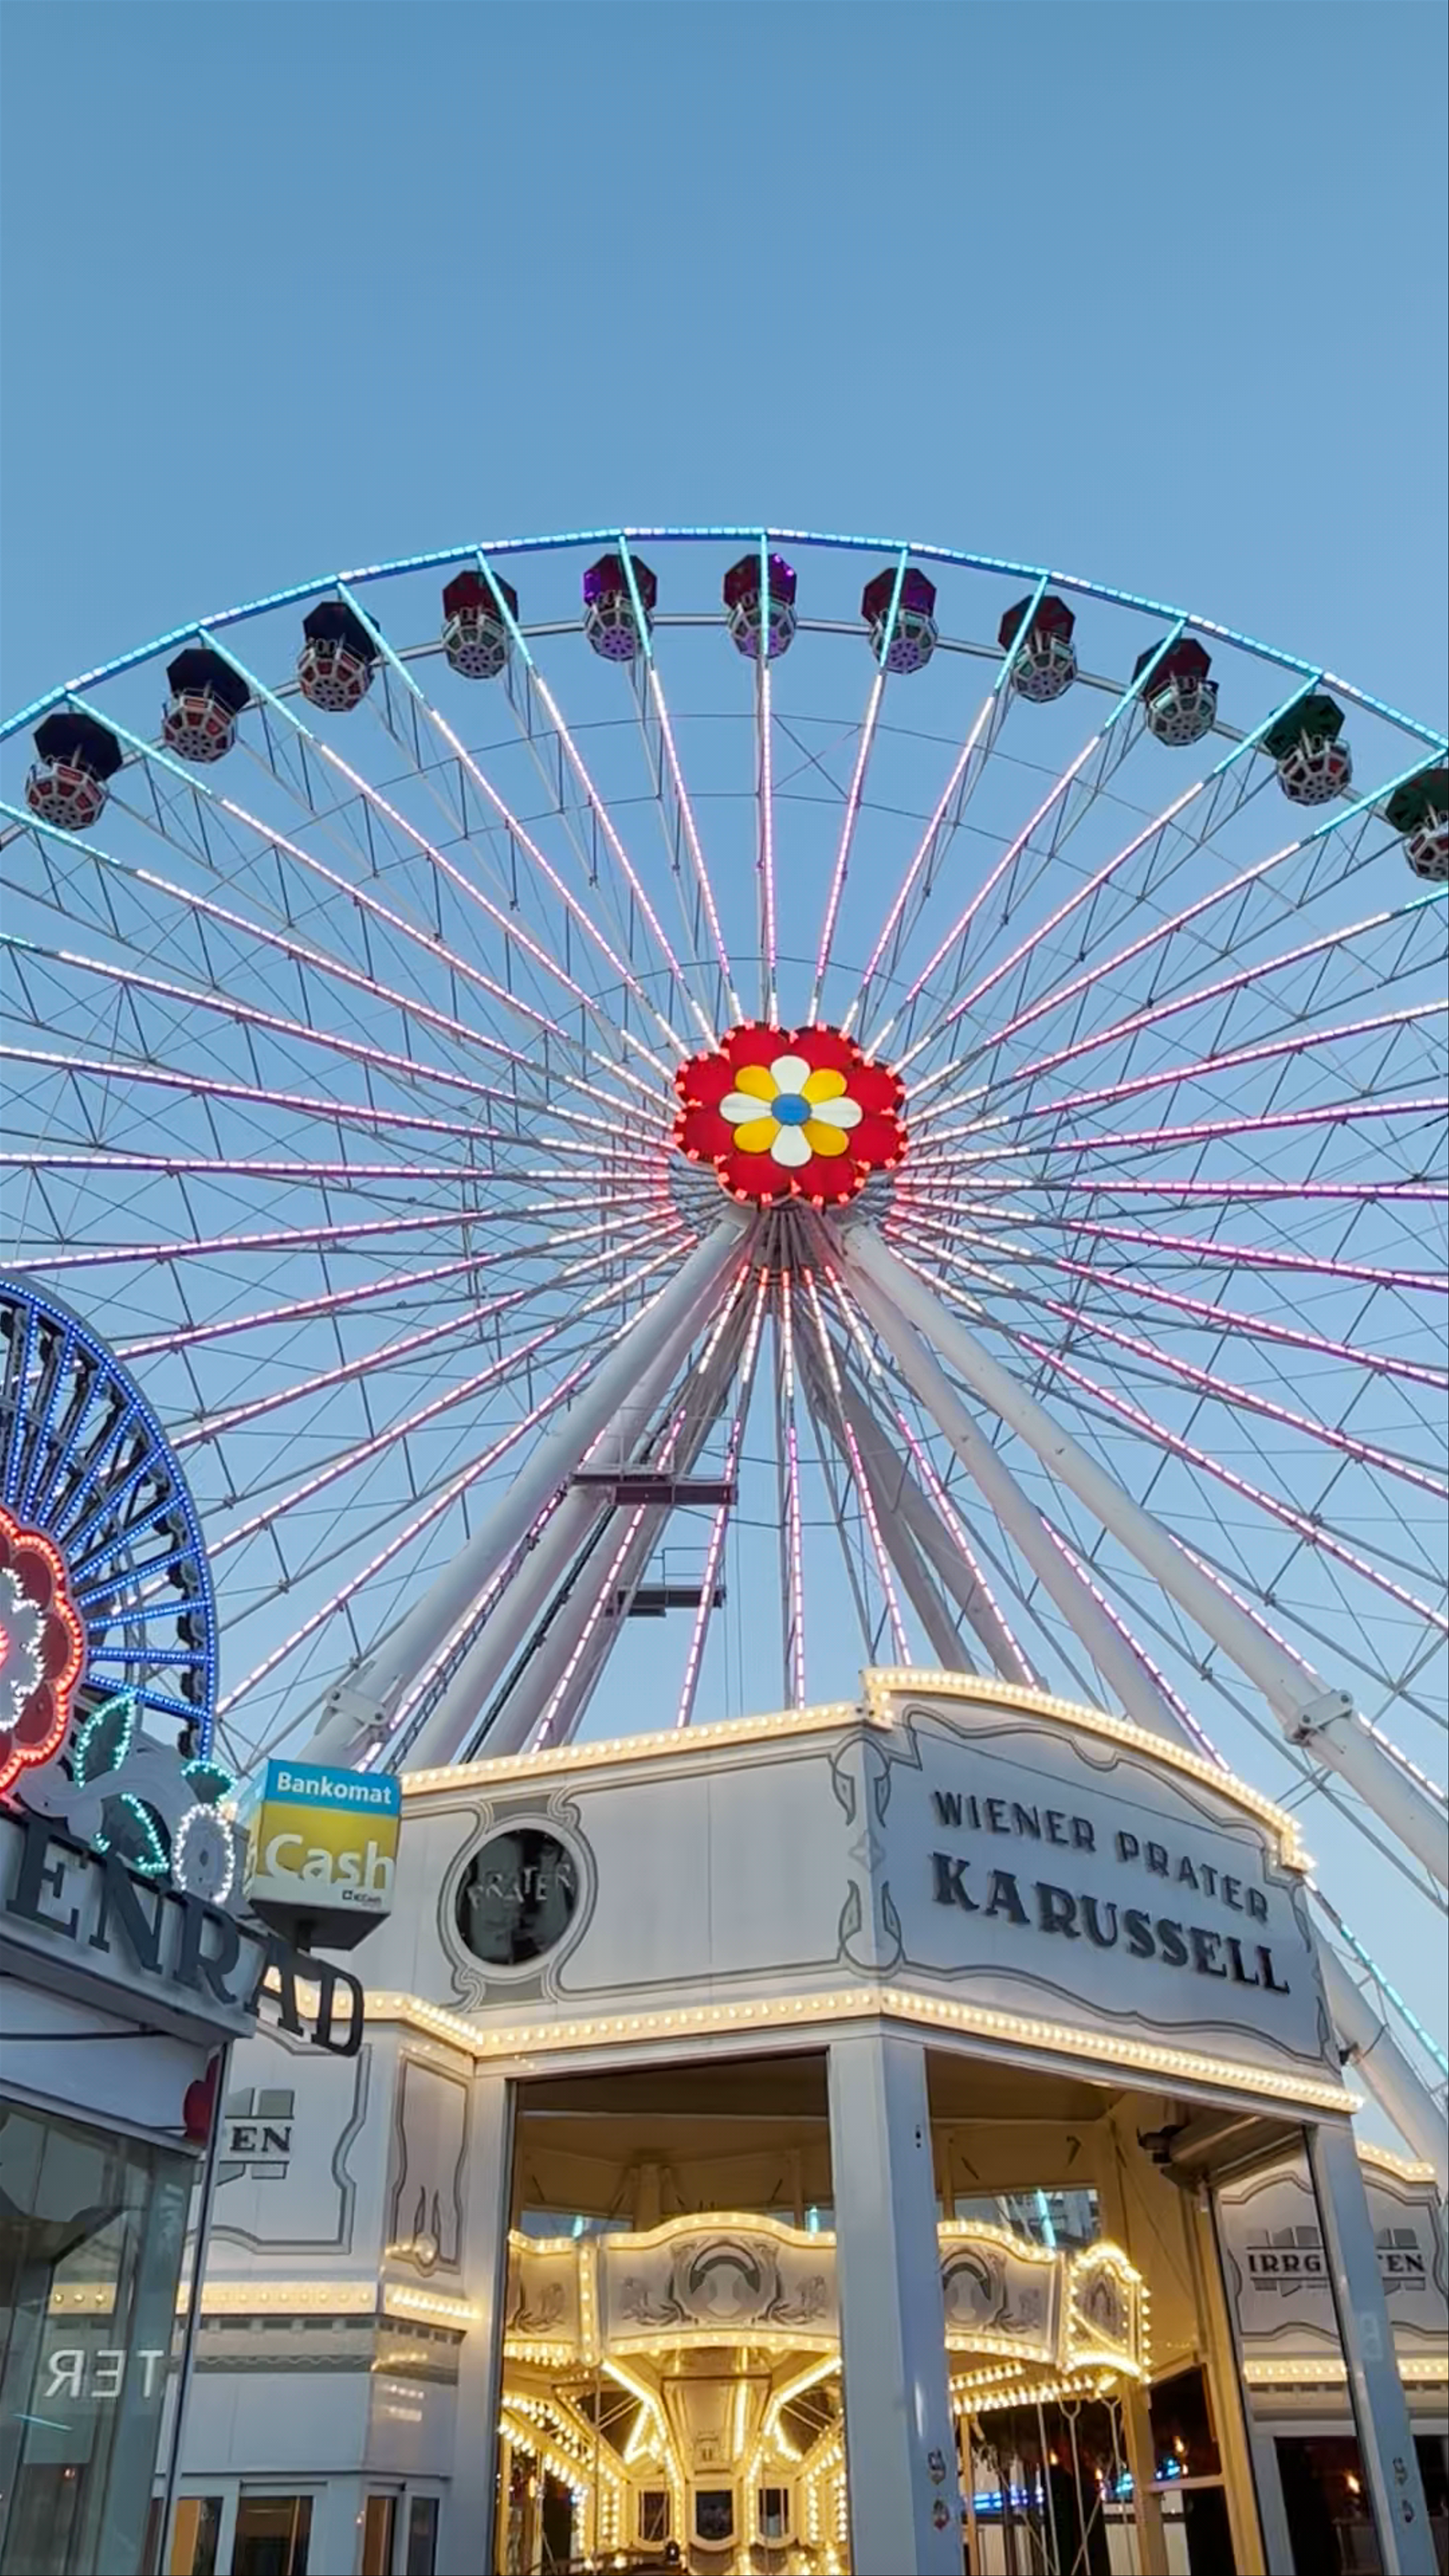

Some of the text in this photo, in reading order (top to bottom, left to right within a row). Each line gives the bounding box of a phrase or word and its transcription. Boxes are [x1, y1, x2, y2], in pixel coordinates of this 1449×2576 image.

[277, 1772, 391, 1804] Bankomat
[266, 1834, 395, 1890] Cash
[934, 1791, 1268, 1923] WIENER PRATER
[931, 1852, 1291, 1995] KARUSSELL
[1248, 2254, 1426, 2273] IRRGEN
